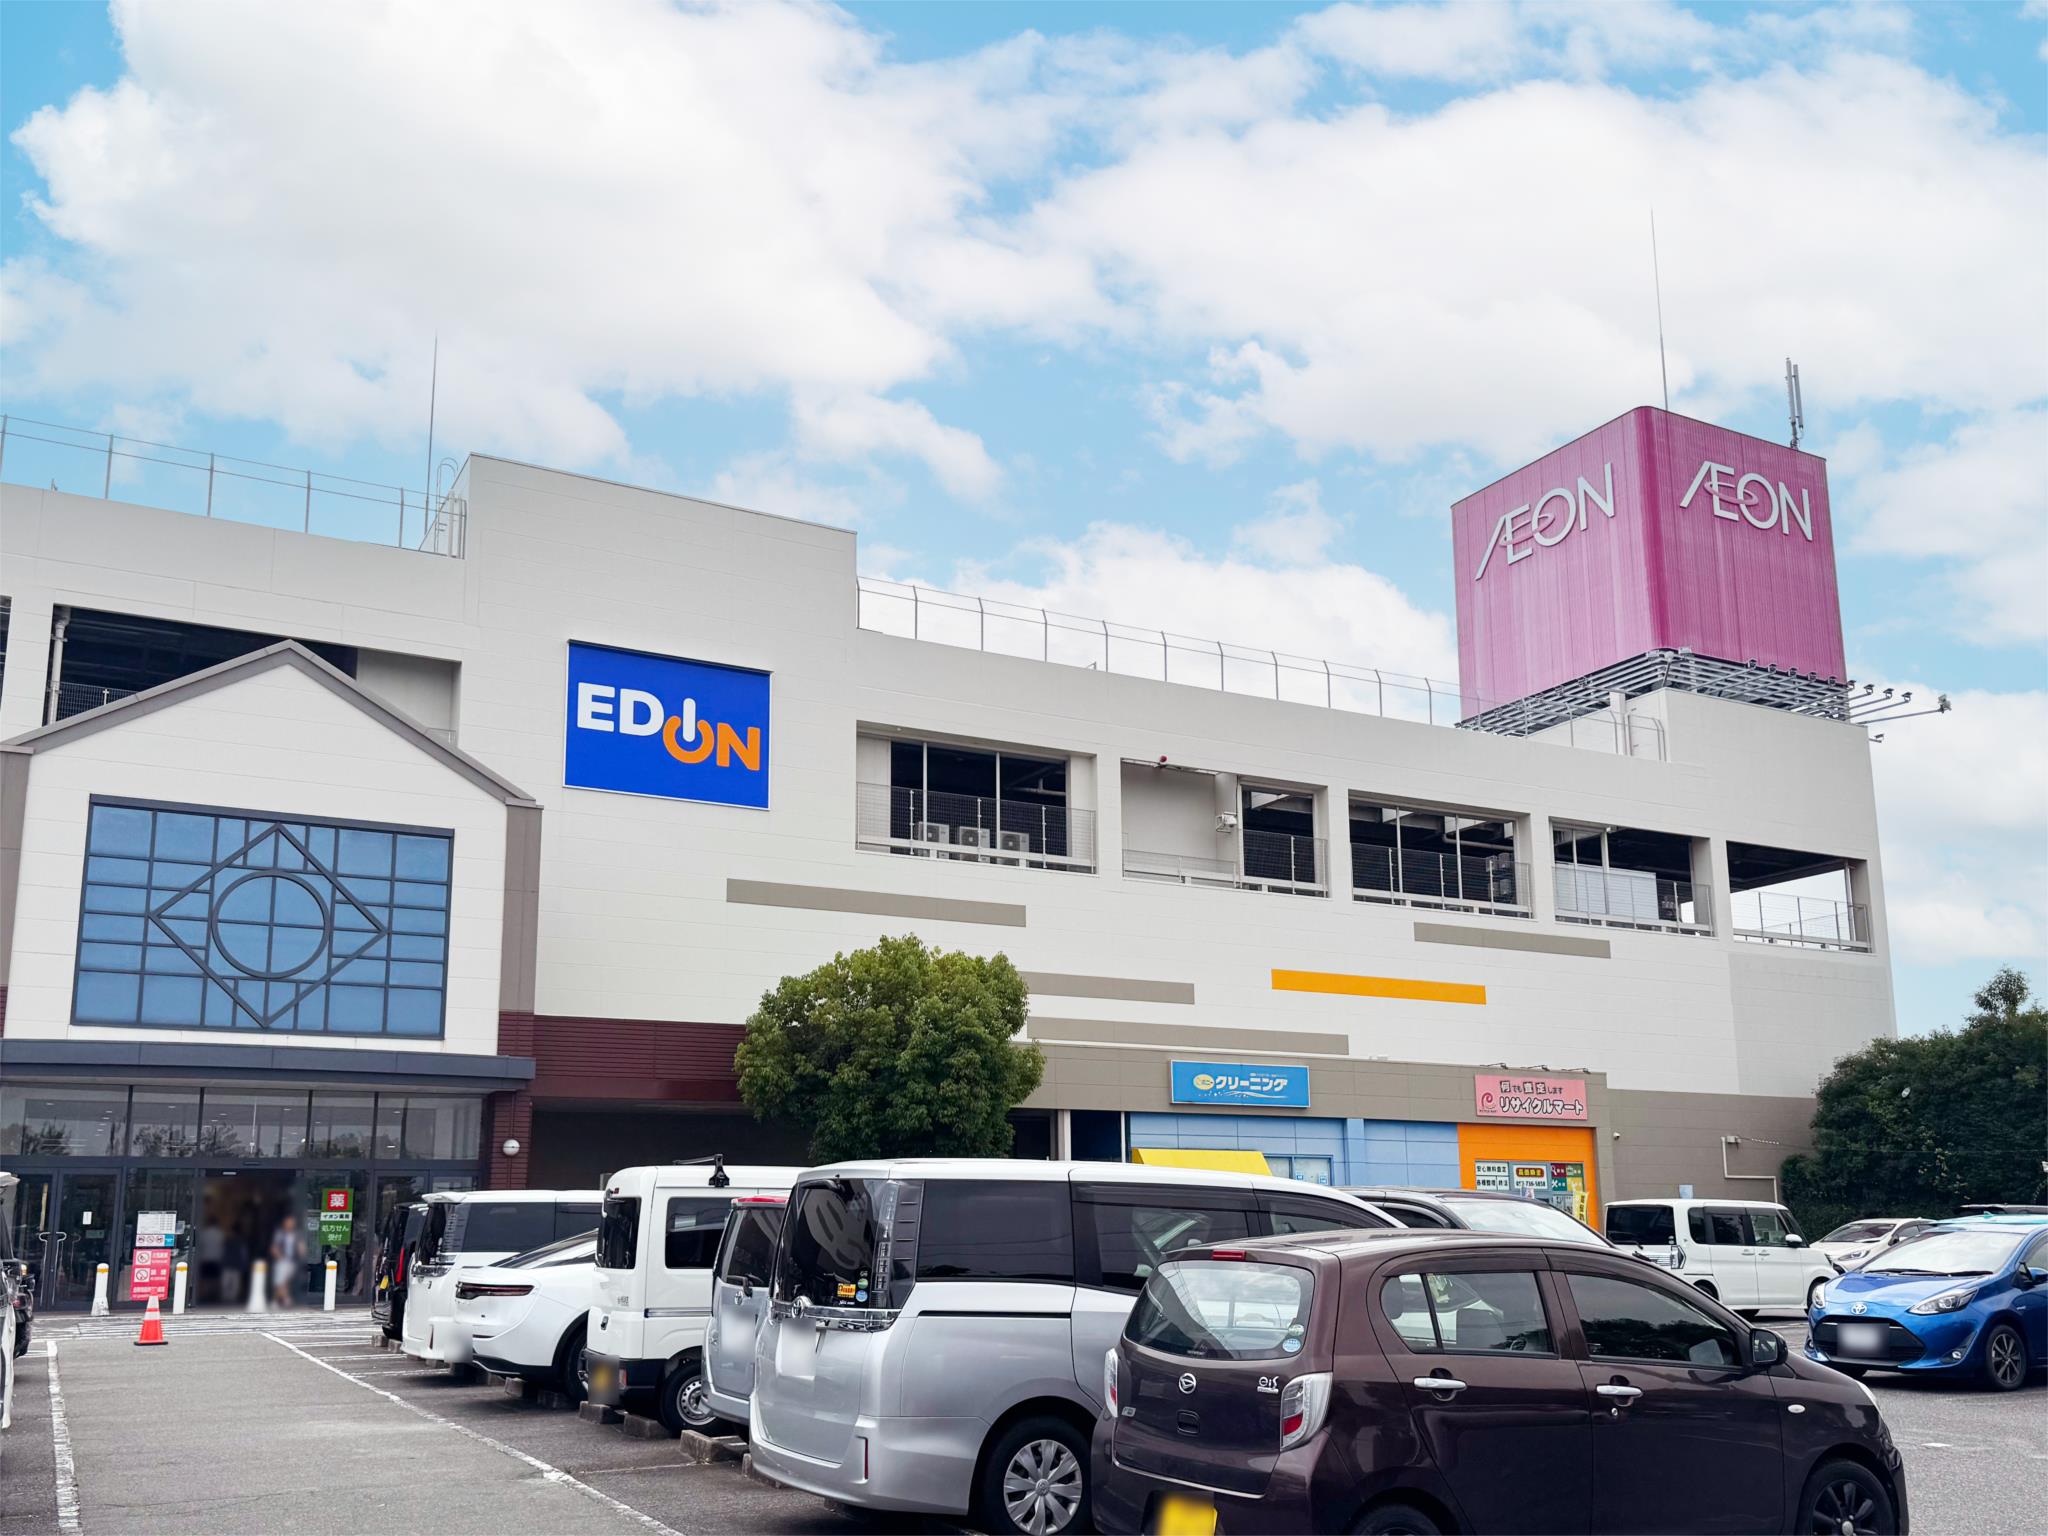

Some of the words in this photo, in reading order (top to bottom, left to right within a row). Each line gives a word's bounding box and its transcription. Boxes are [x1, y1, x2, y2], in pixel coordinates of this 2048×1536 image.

[577, 682, 761, 771] EDION
[1215, 1075, 1288, 1092] クリーニング
[1499, 1096, 1583, 1116] リサイクルマート
[330, 1193, 345, 1207] 薬
[321, 1224, 349, 1233] 処方せん
[327, 1233, 343, 1241] 受付
